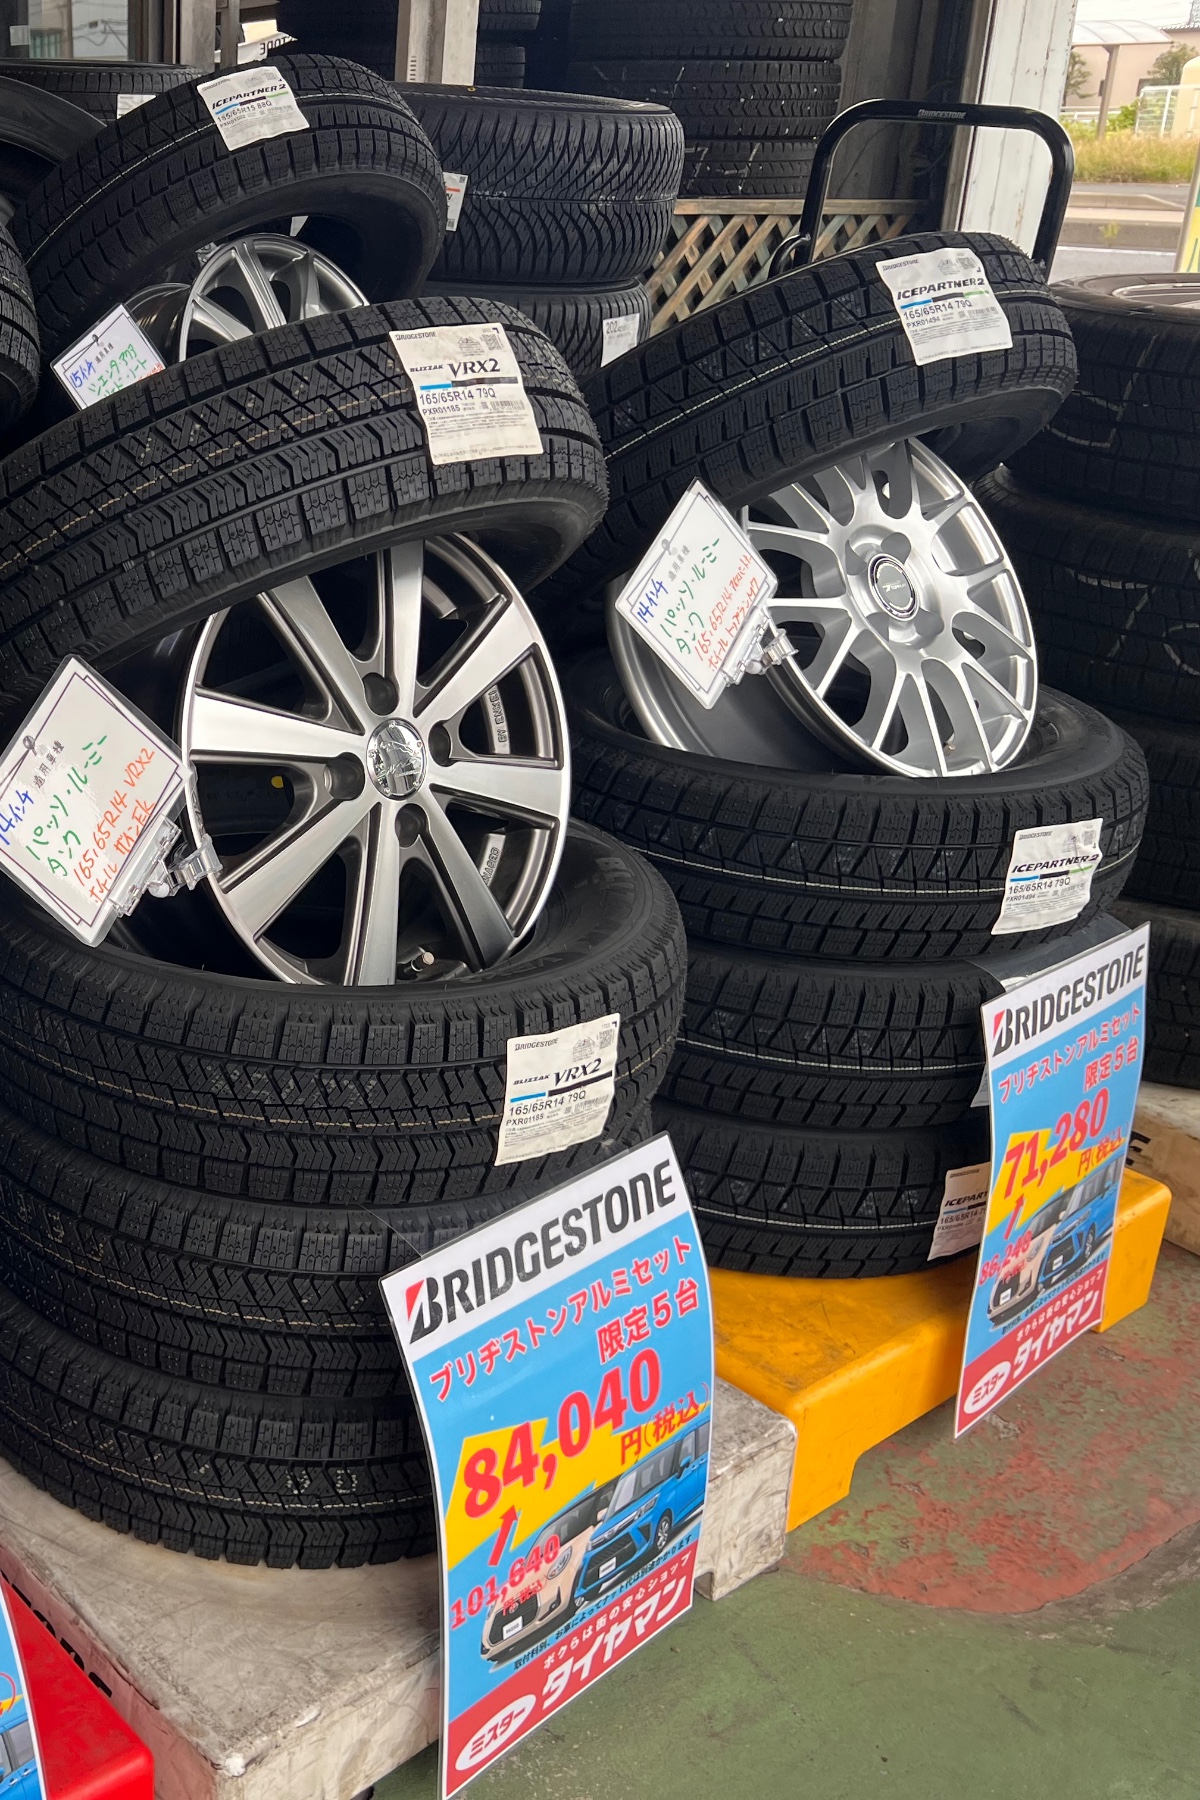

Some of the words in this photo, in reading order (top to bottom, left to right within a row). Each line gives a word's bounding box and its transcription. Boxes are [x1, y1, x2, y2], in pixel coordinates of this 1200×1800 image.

[903, 304, 953, 320] 165/65R14
[955, 300, 973, 308] 79Q
[420, 390, 474, 405] 165/65R14
[476, 388, 496, 399] 79Q
[447, 358, 500, 378] VRX2
[33, 741, 65, 789] 適用車種
[47, 830, 81, 877] タンク
[1008, 880, 1053, 894] 165/65R14
[1055, 877, 1071, 886] 79Q
[992, 943, 1146, 1058] BRIDGESTONE
[514, 1038, 559, 1051] BRIDGESTONE
[554, 1058, 601, 1086] VRX2
[999, 1002, 1140, 1104] ブリヂストンアルミセット
[1083, 1037, 1140, 1093] 限定5台
[506, 1113, 544, 1126] PXR01185
[509, 1097, 564, 1116] 165/65R14
[568, 1090, 586, 1103] 79Q
[1005, 1087, 1109, 1192] 71,280
[405, 1159, 676, 1344] BRIDGESTONE
[430, 1235, 691, 1402] ブリヂストンアルミセット
[596, 1277, 700, 1364] 限定5台
[972, 1367, 1008, 1407] ミスター
[1013, 1290, 1100, 1379] タイヤマン
[463, 1348, 661, 1519] 84,040
[620, 1382, 710, 1466] 円(税込)
[450, 1534, 561, 1630] 101,640
[543, 1551, 691, 1669] ボクらは街の安心ショップ
[469, 1708, 526, 1760] ミスター
[542, 1575, 687, 1710] タイヤマン
